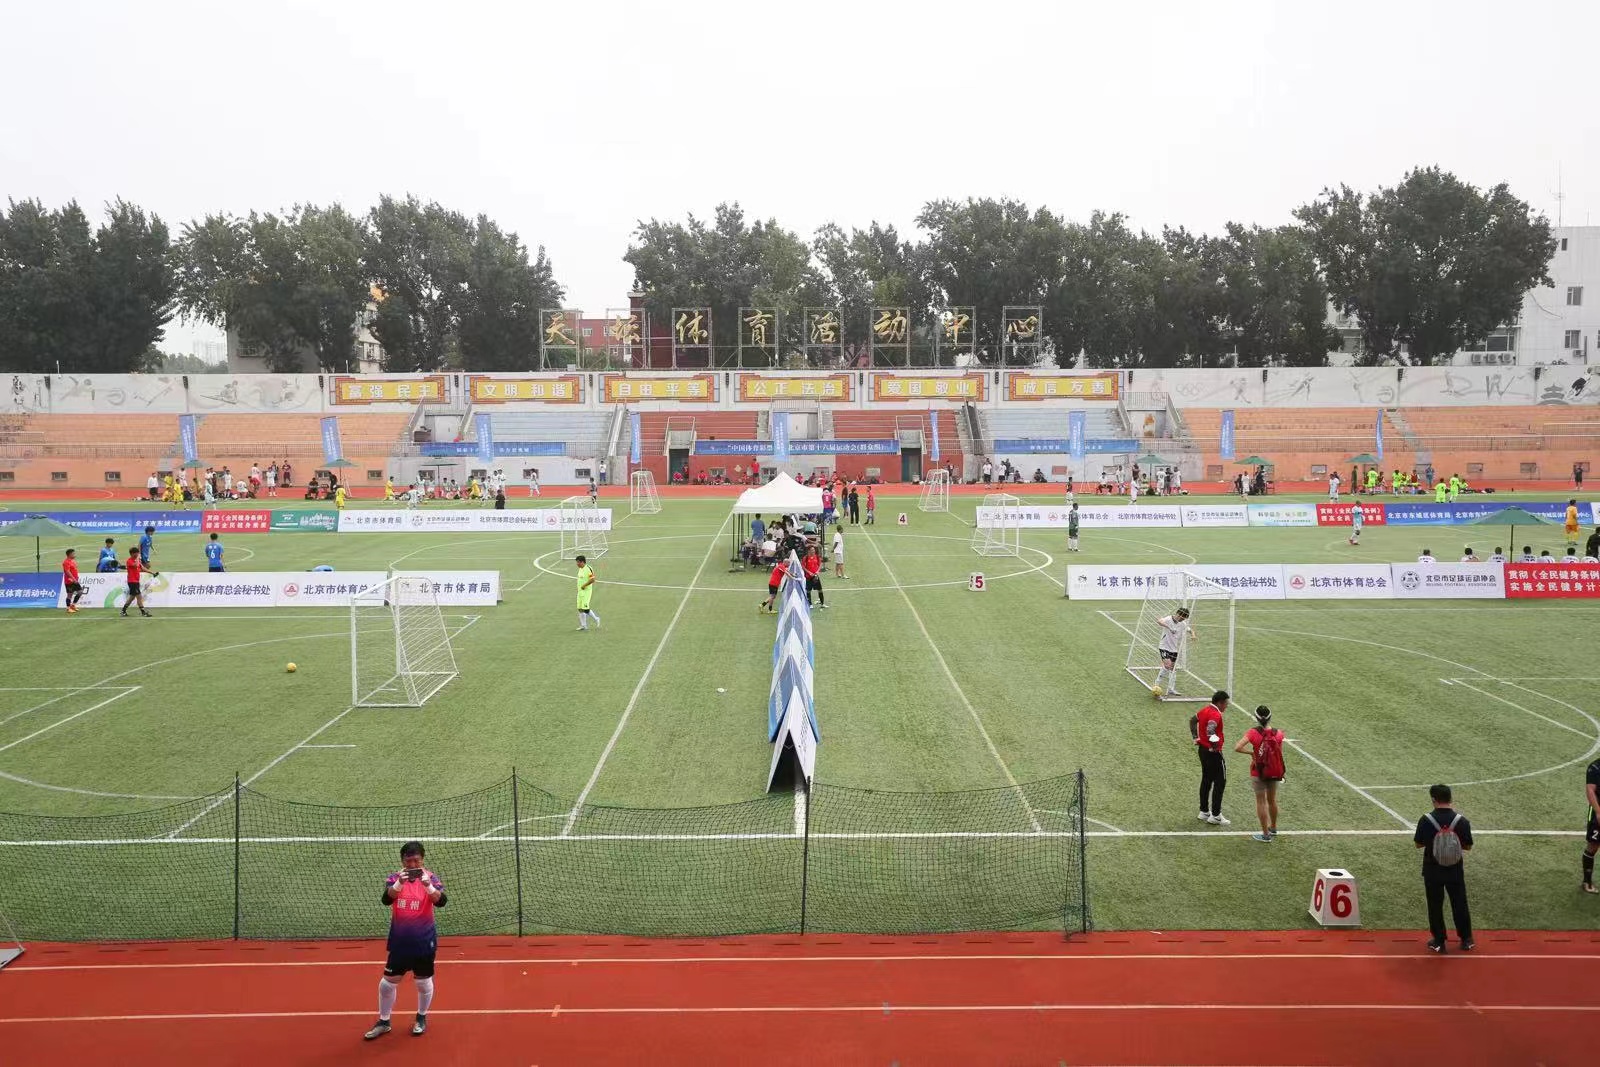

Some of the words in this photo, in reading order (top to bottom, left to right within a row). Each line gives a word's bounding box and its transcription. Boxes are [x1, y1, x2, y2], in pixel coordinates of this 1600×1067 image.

[545, 308, 1039, 347] 天坛体育活动中心
[348, 384, 432, 399] 富强民主
[483, 383, 568, 398] 文明和谐
[618, 382, 702, 396] 自由平等
[754, 381, 837, 396] 公正法治
[887, 380, 970, 395] 爱国敬业
[1023, 380, 1106, 395] 诚信友善
[356, 516, 402, 524] 北京市体育局
[899, 514, 905, 523] 4
[419, 582, 491, 594] 北京市体育局
[975, 575, 984, 588] 5
[1096, 576, 1169, 587] 北京市体育局
[1310, 576, 1387, 588] 北京市体育总会
[1510, 582, 1600, 592] 实施全民健身计
[177, 584, 271, 596] 北京市体育总会秘书处
[1314, 878, 1325, 912] 6
[1330, 884, 1352, 918] 6
